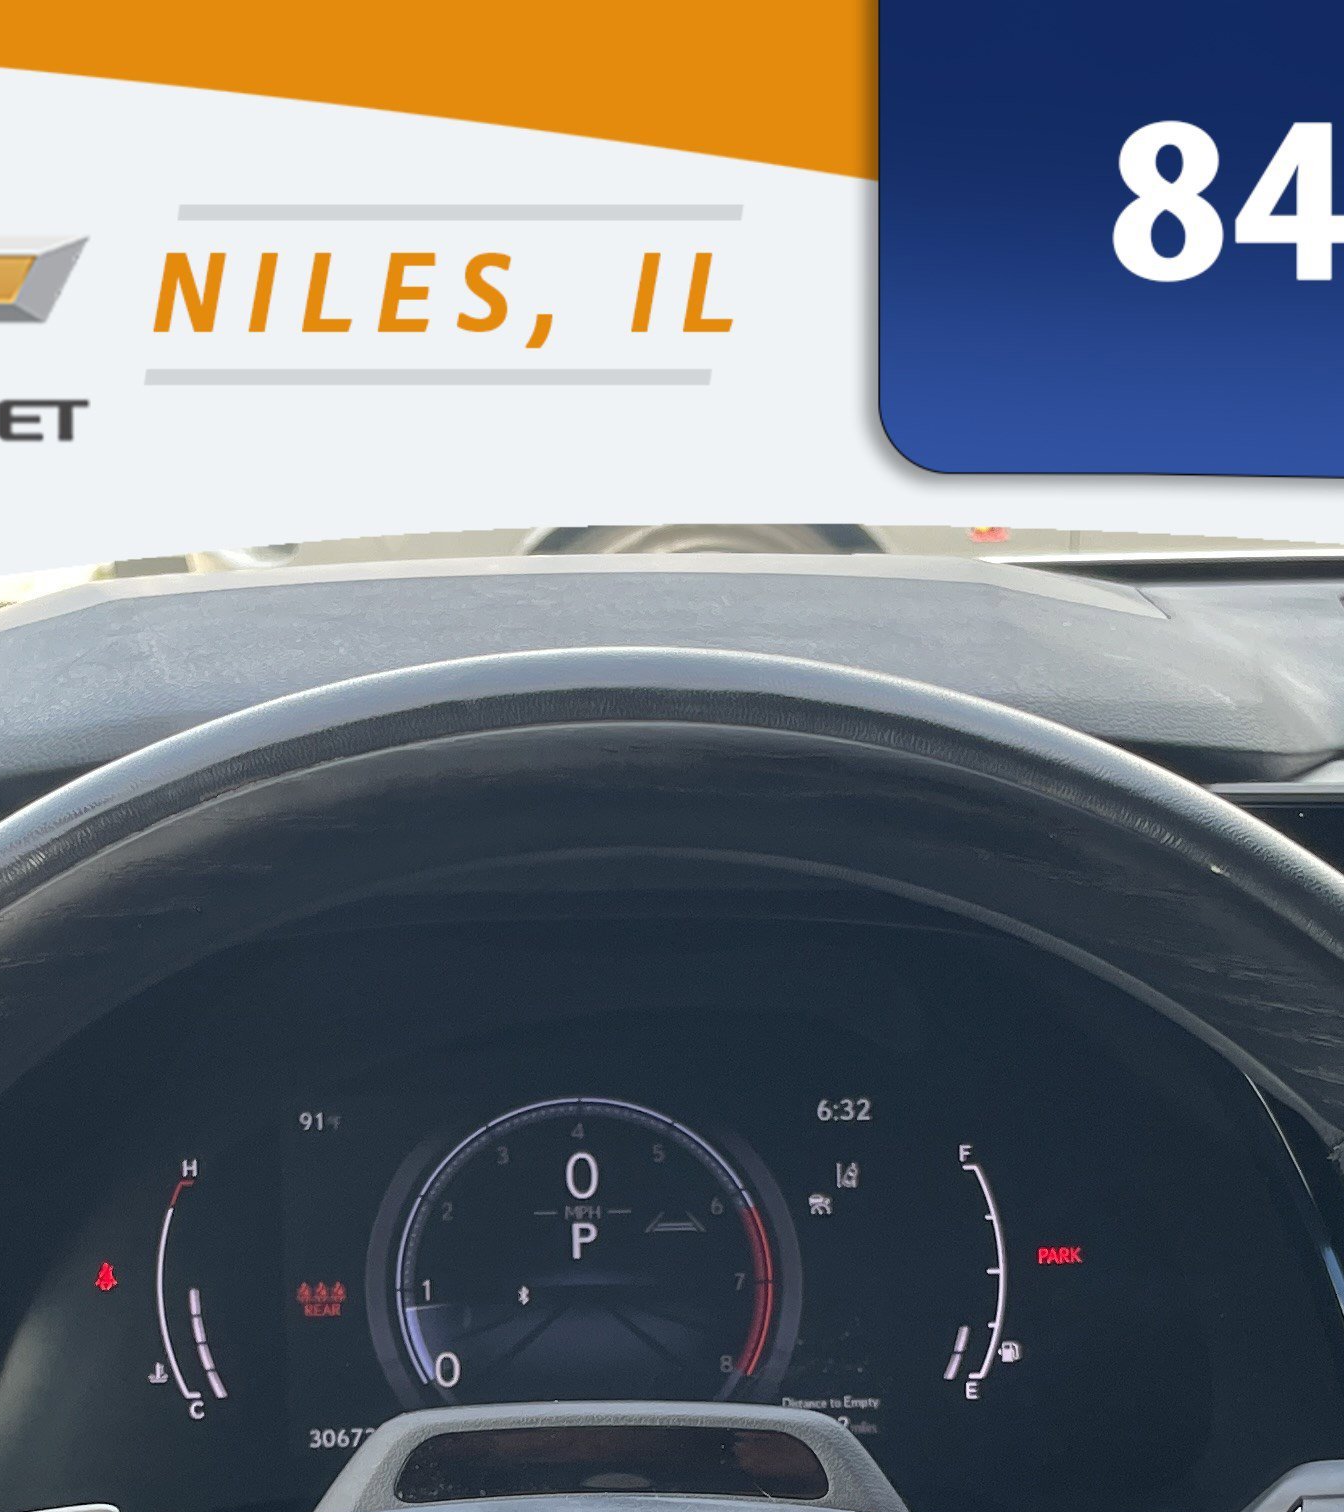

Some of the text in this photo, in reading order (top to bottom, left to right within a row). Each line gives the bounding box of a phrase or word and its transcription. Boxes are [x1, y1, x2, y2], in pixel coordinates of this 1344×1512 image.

[816, 1098, 872, 1121] 6:32
[570, 1123, 585, 1140] 4
[497, 1146, 510, 1165] 3
[959, 1144, 972, 1162] F
[182, 1159, 199, 1178] H
[565, 1152, 599, 1200] 0
[442, 1202, 454, 1221] 2
[564, 1204, 601, 1220] MPH
[710, 1197, 724, 1216] 6
[571, 1222, 598, 1260] P
[1037, 1245, 1083, 1265] PARK
[421, 1279, 432, 1301] 1
[733, 1272, 747, 1291] 7
[304, 1303, 342, 1317] REAR
[435, 1351, 461, 1387] 0
[720, 1354, 734, 1373] 8
[965, 1381, 979, 1399] E
[189, 1400, 205, 1420] C
[830, 1399, 843, 1409] to
[843, 1395, 881, 1410] Empty
